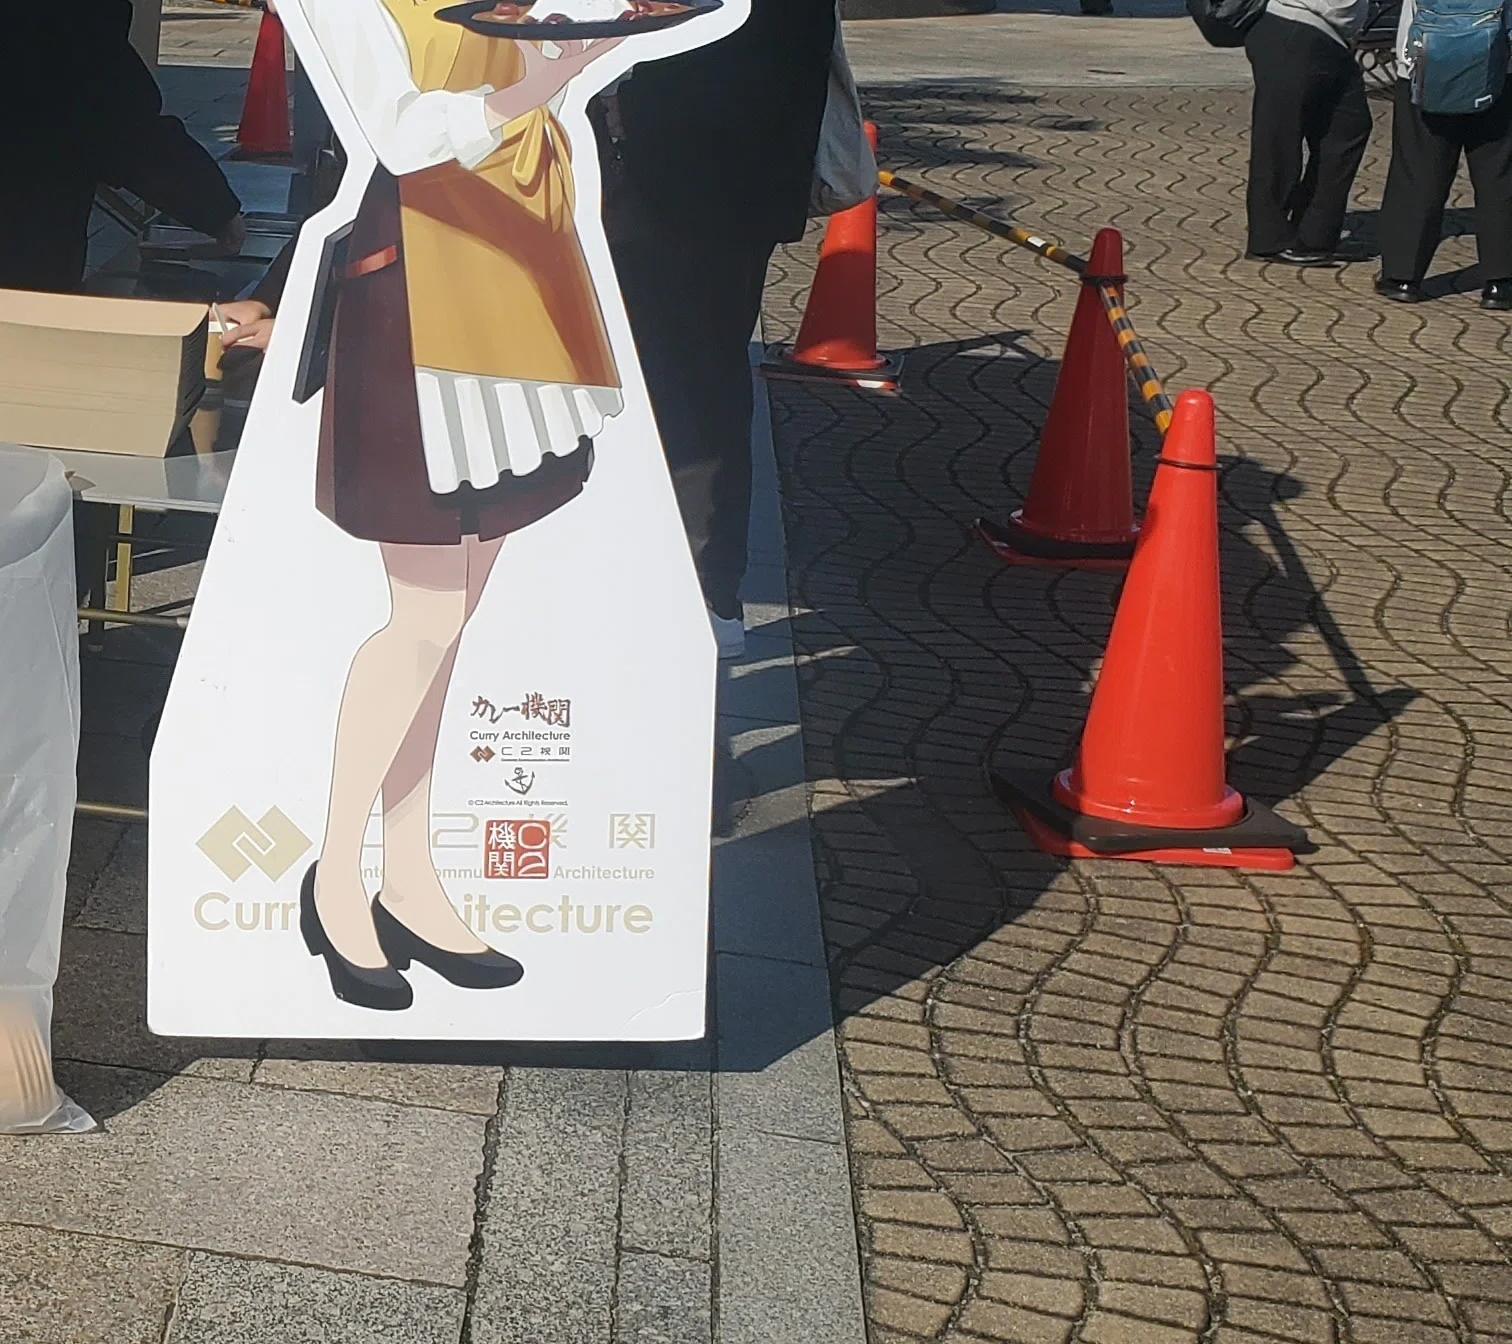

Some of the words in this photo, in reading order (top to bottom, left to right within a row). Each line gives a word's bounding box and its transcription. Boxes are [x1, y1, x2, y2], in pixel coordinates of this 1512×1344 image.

[470, 692, 571, 728] カレー機関
[469, 731, 500, 742] Curry
[502, 730, 571, 740] Architecture
[553, 865, 655, 879] Architecture
[194, 891, 297, 931] Curr
